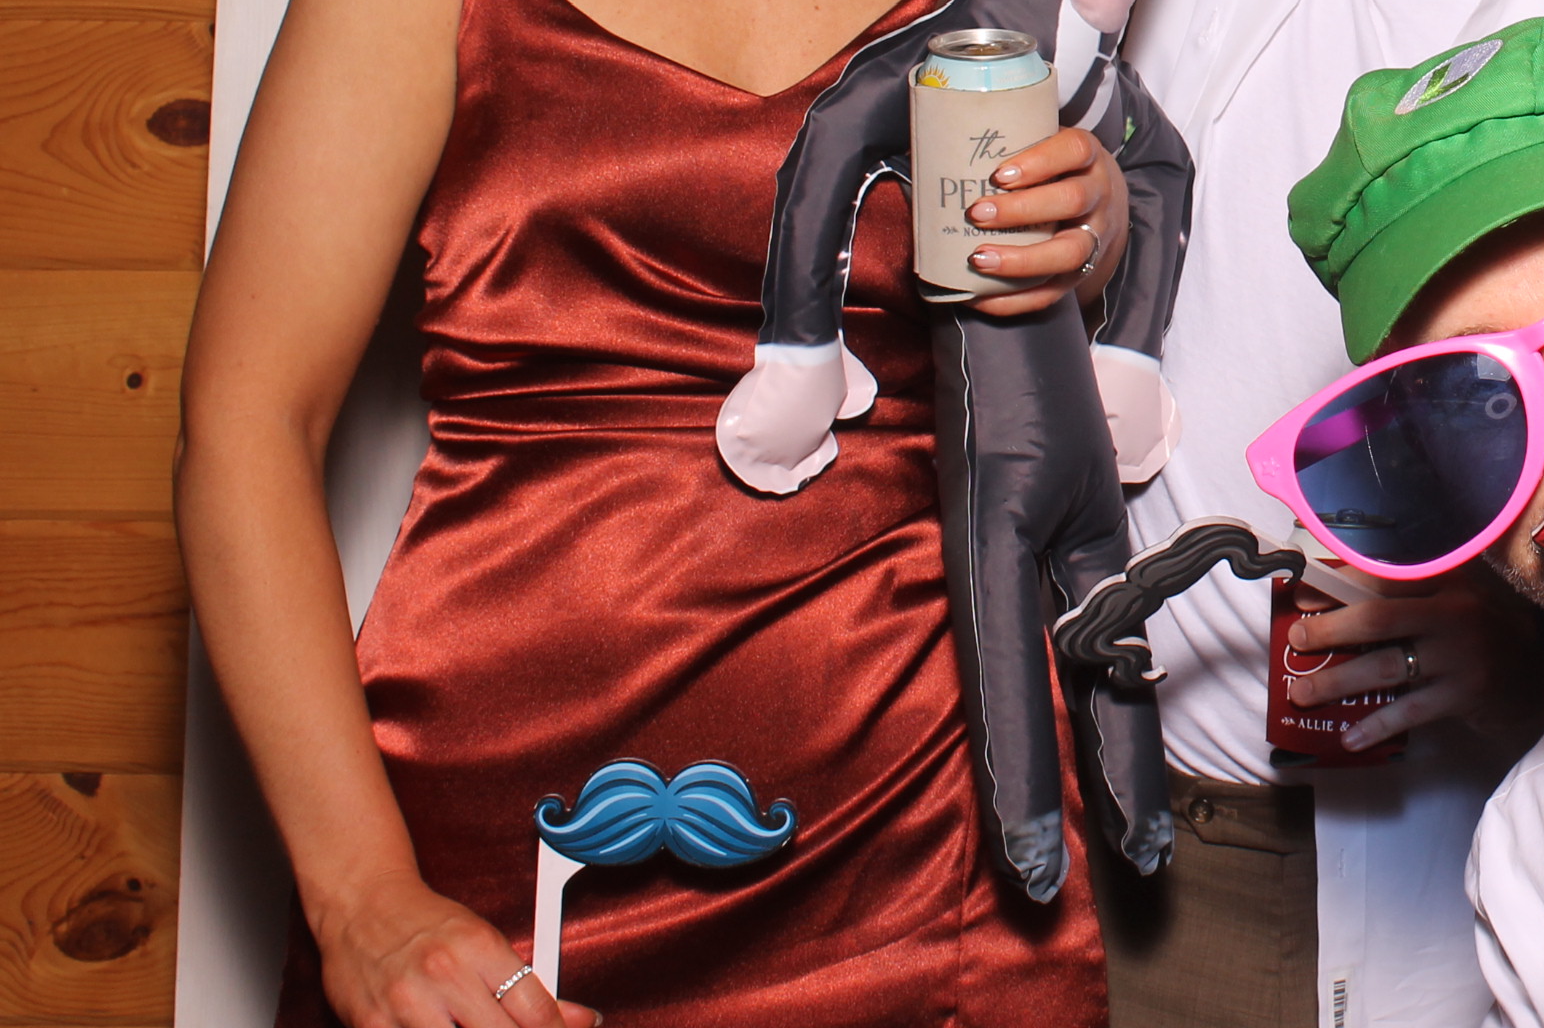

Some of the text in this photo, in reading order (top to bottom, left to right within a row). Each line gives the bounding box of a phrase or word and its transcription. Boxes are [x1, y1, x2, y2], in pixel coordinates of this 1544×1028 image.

[969, 128, 1042, 167] the
[1298, 718, 1351, 732] ALLIE &
